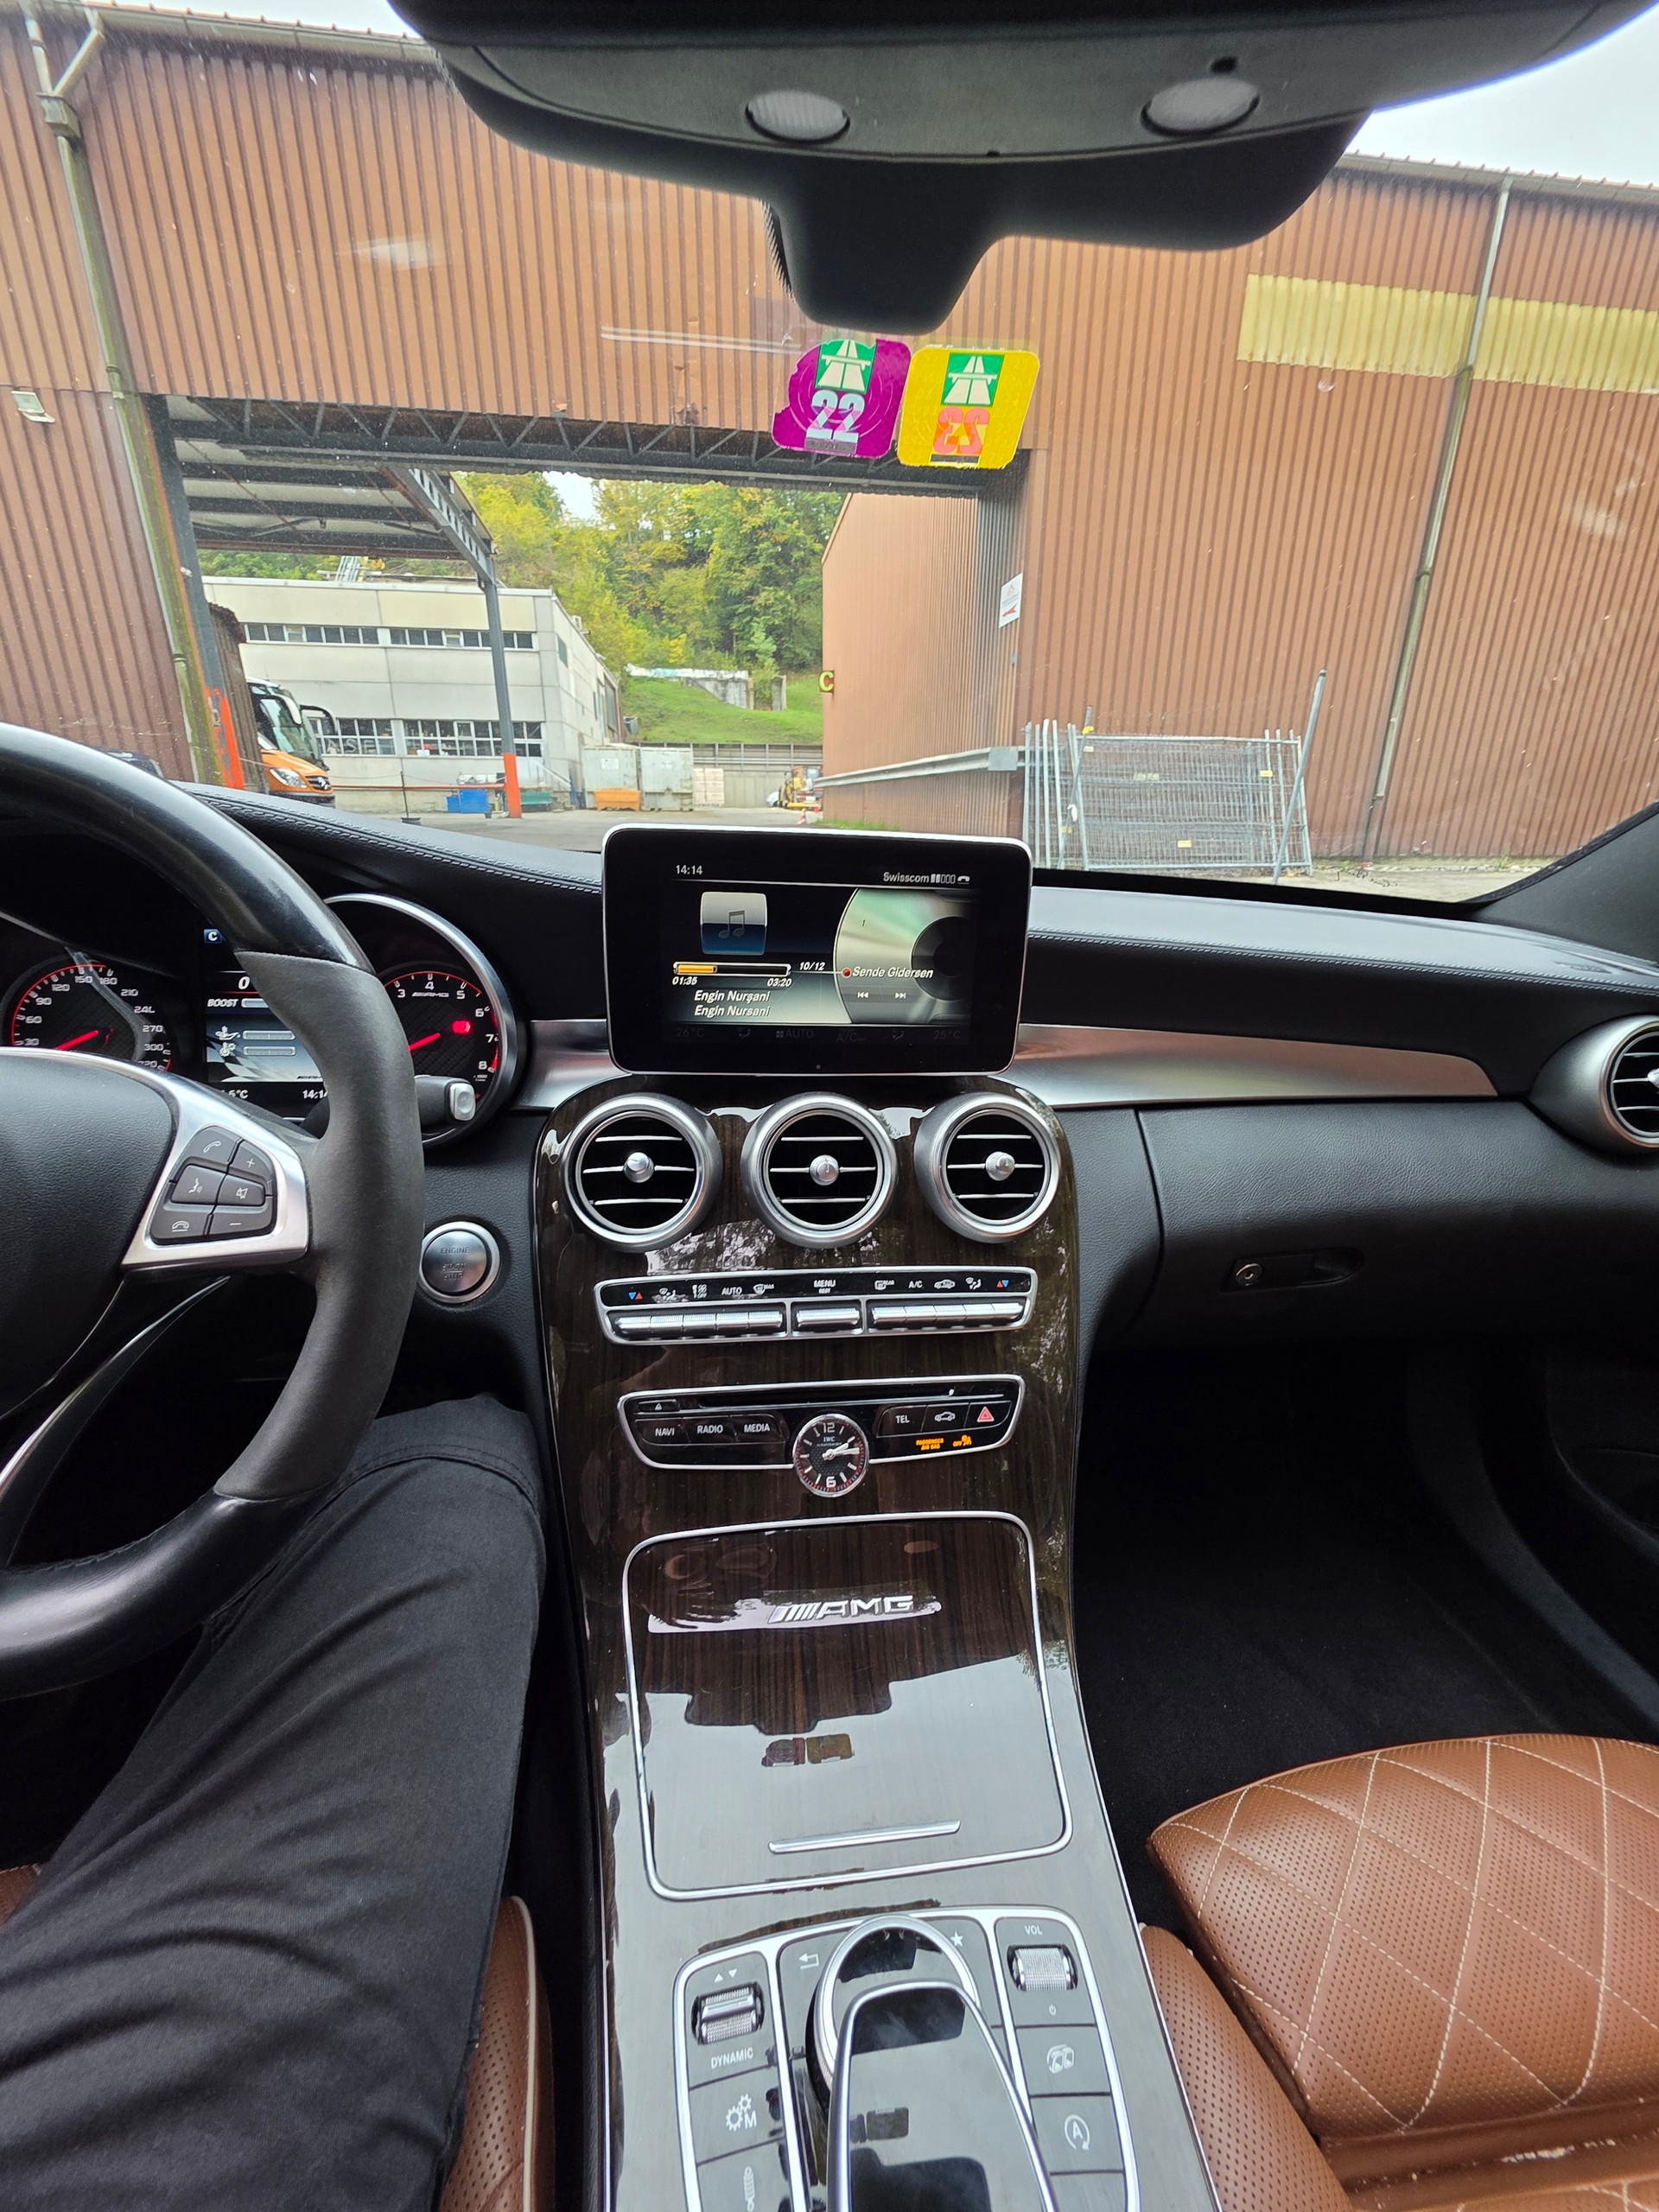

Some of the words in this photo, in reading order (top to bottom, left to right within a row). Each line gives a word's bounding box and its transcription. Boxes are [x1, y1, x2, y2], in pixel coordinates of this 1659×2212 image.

[805, 390, 865, 443] 22
[819, 671, 834, 691] C
[675, 865, 703, 875] 14:14
[883, 871, 930, 884] Swisscom
[208, 931, 218, 941] C
[799, 962, 825, 971] 10/12
[852, 966, 885, 977] Sende
[887, 967, 934, 979] Gidersen
[238, 976, 250, 989] 0
[424, 982, 435, 990] 4
[767, 978, 791, 988] 03:20
[397, 989, 406, 998] 3
[456, 990, 466, 1000] 5
[694, 990, 725, 1002] Engin
[35, 997, 52, 1006] 90
[207, 998, 238, 1007] BOOST
[475, 1008, 484, 1017] 6
[694, 1005, 726, 1017] Engin
[24, 1038, 39, 1046] 30
[486, 1033, 494, 1043] 7
[479, 1061, 487, 1070] 8
[814, 1279, 836, 1287] MENU
[908, 1281, 923, 1289] A/C
[721, 1287, 742, 1295] AUTO
[895, 1414, 910, 1423] TEL
[655, 1427, 675, 1436] NAVI
[696, 1425, 724, 1434] RADIO
[744, 1423, 770, 1433] MEDIA
[823, 1422, 836, 1433] 12
[826, 1476, 836, 1488] 6
[816, 1594, 914, 1619] AMG
[1024, 1924, 1043, 1936] VOL
[710, 2047, 754, 2069] DYNAMIC
[745, 2110, 757, 2129] M
